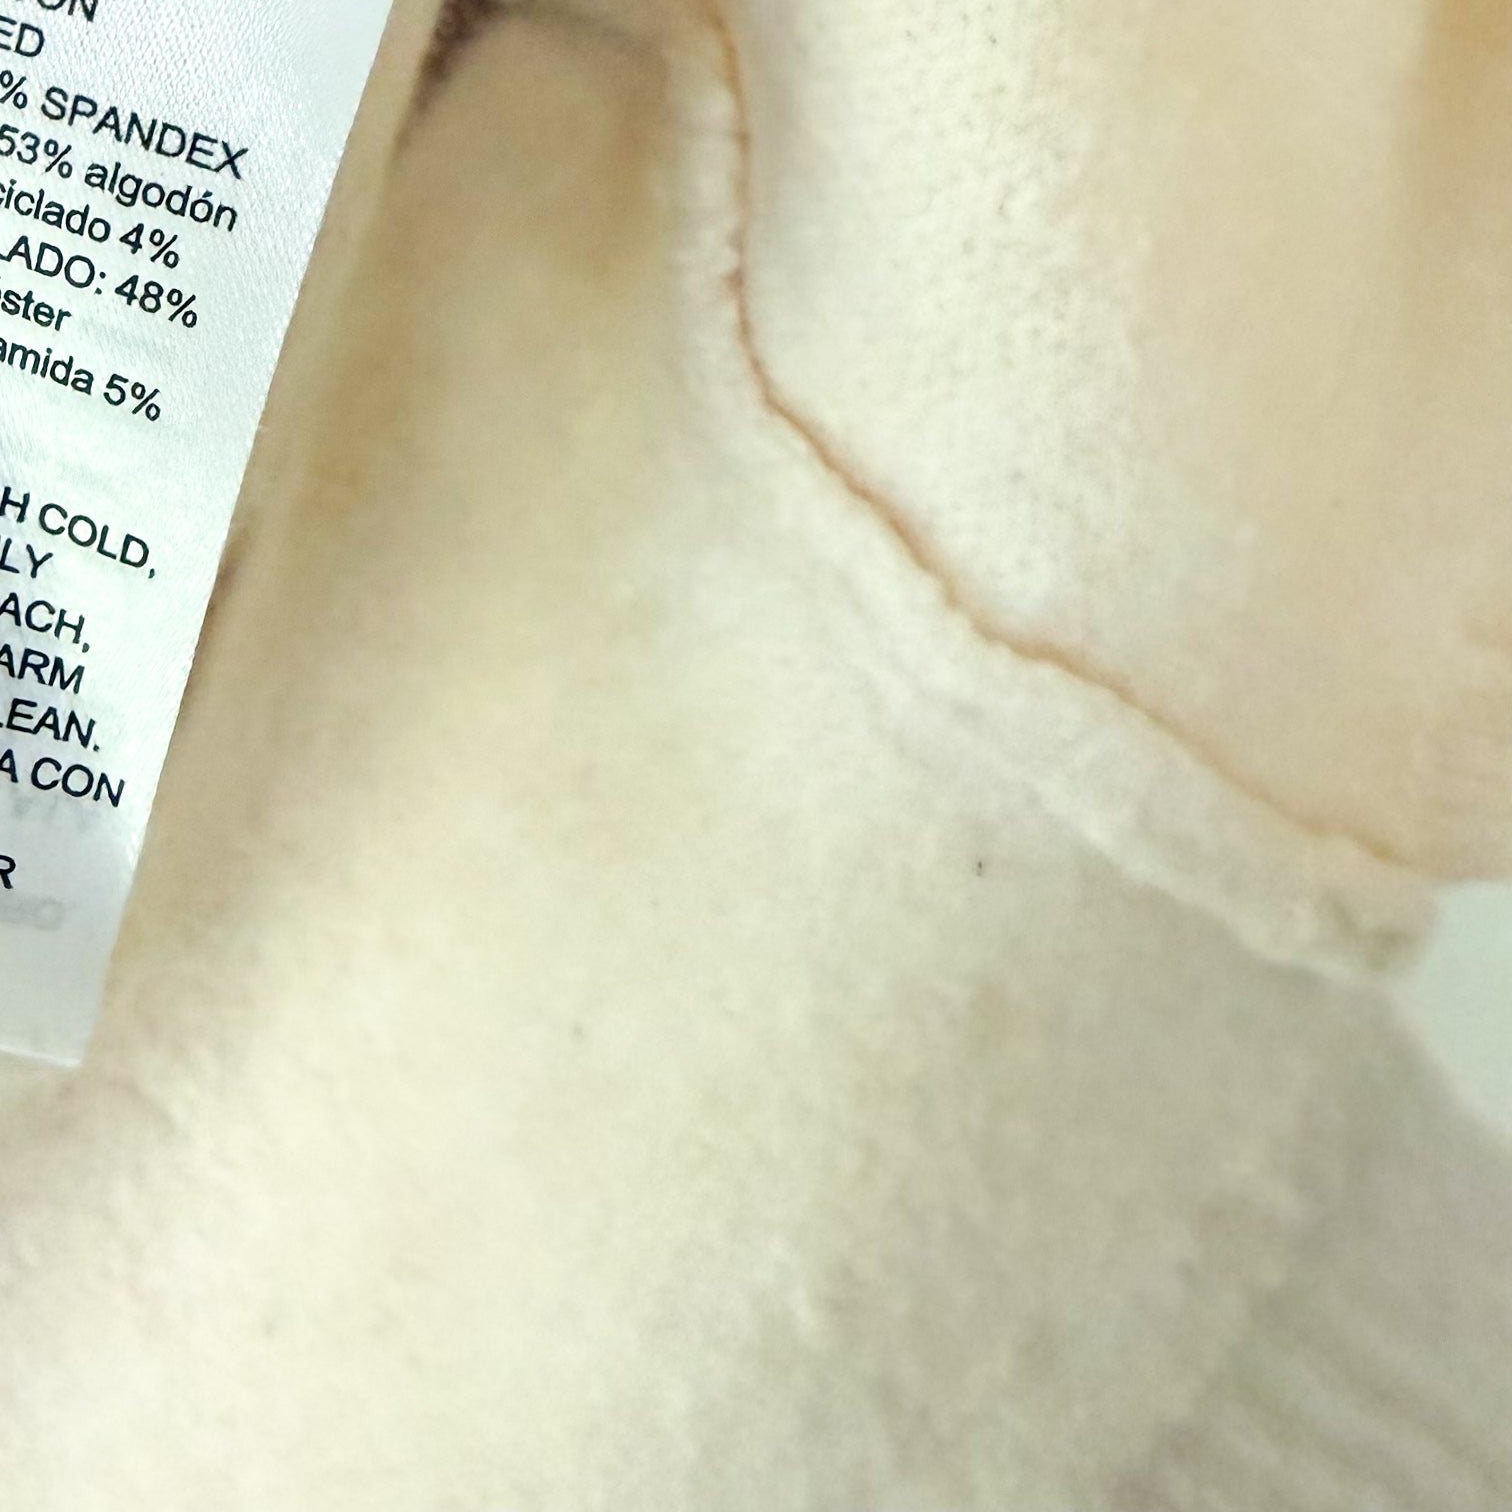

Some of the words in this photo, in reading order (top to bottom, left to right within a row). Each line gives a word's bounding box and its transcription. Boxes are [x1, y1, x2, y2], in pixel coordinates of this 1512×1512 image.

[40, 85, 249, 180] SPANDEX
[84, 161, 238, 233] algodón
[118, 222, 180, 270] 4%
[114, 274, 198, 329] 48%
[103, 373, 161, 422] 5%
[38, 502, 155, 579] COLD,
[30, 756, 125, 808] CON
